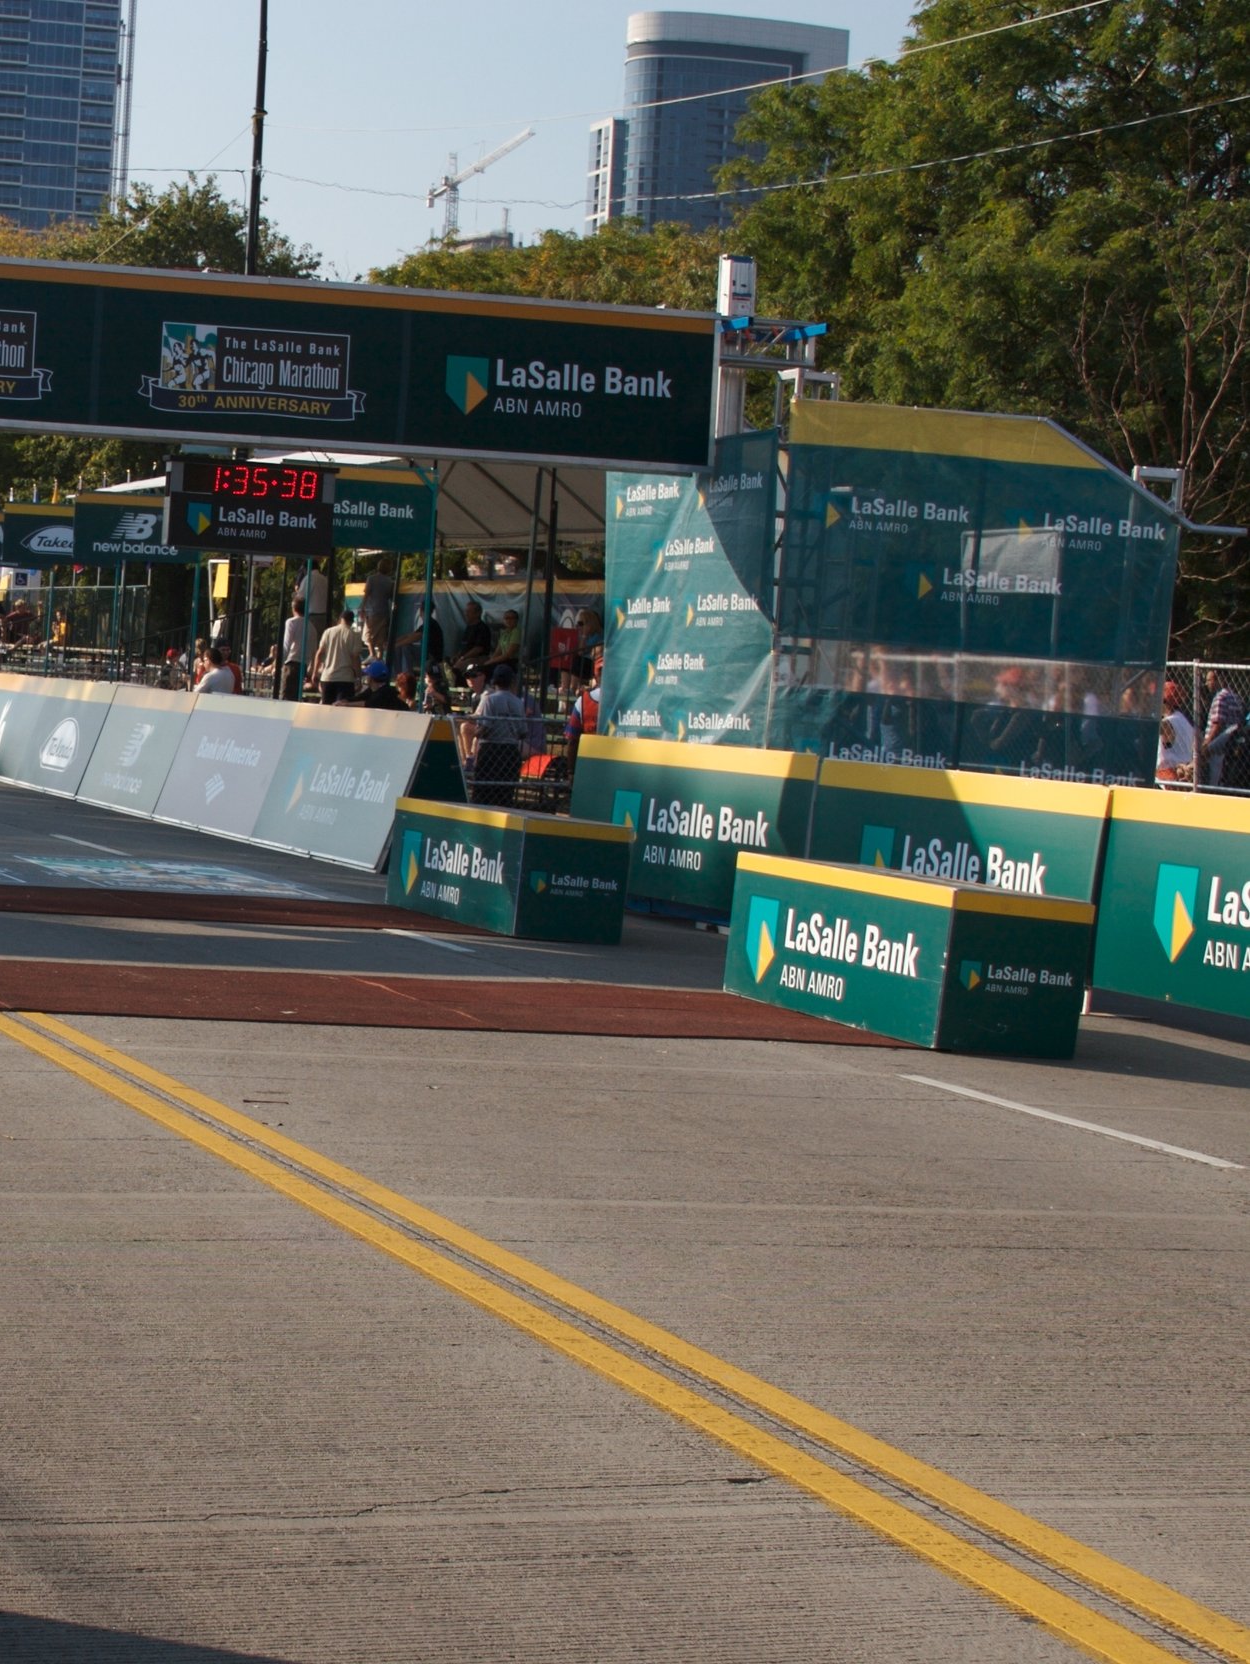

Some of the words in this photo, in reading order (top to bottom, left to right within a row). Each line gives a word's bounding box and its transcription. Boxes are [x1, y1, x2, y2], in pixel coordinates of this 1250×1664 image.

[224, 337, 247, 349] The
[254, 339, 302, 353] LaSalle
[309, 343, 340, 356] Bank
[223, 356, 274, 390] Chicago
[279, 360, 339, 390] Marathon
[496, 358, 596, 392] LaSalle
[604, 367, 672, 398] Bank
[178, 394, 207, 408] 30th
[214, 396, 331, 415] ANNIVERSARY
[493, 397, 528, 414] ABN
[533, 400, 582, 418] AMRO
[626, 486, 657, 502] LaSalle
[658, 482, 680, 500] Bank
[709, 475, 738, 493] LaSalle
[740, 472, 763, 490] Bank
[219, 507, 275, 525] LaSalle
[278, 511, 317, 530] Bank
[333, 500, 375, 517] aSalle
[379, 502, 414, 519] Bank
[851, 496, 919, 518] LaSalle
[923, 502, 970, 524] Bank
[217, 527, 237, 537] ABN
[239, 528, 267, 540] AMRO
[344, 518, 369, 528] AMRO
[849, 519, 873, 531] ABN
[876, 521, 909, 534] AMRO
[1043, 512, 1112, 536] LaSalle
[1118, 517, 1165, 541] Bank
[665, 539, 694, 556] LaSalle
[695, 537, 714, 553] Bank
[1068, 538, 1101, 551] AMRO
[943, 567, 1010, 592] LaSalle
[1014, 574, 1062, 595] Bank
[652, 597, 670, 613] Bank
[697, 595, 728, 611] LaSalle
[731, 594, 759, 611] Bank
[941, 590, 964, 603] ABN
[967, 592, 999, 605] AMRO
[657, 654, 682, 670] LaSalle
[684, 653, 704, 671] Bank
[618, 711, 641, 726] LaSalle
[642, 711, 661, 727] Bank
[688, 712, 724, 729] LaSalle
[829, 741, 895, 765] LaSalle
[900, 748, 946, 770] Bank
[310, 763, 356, 798] LaSalle
[354, 770, 391, 804] Bank
[1020, 760, 1086, 783] LaSalle
[1091, 769, 1138, 787] Bank
[647, 798, 714, 840] LaSalle
[717, 806, 769, 848] Bank
[424, 837, 468, 877] LaSalle
[471, 846, 504, 885] Bank
[643, 844, 666, 866] ABN
[668, 848, 701, 871] AMRO
[901, 834, 980, 883] LaSalle
[986, 846, 1047, 895] Bank
[420, 881, 436, 899] ABN
[438, 884, 460, 905] AMRO
[551, 874, 589, 889] LaSalle
[591, 877, 618, 891] Bank
[784, 908, 857, 964] LaSalle
[861, 924, 920, 978] Bank
[1203, 940, 1237, 970] ABN
[780, 964, 805, 988] ABN
[807, 969, 844, 1001] AMRO
[987, 964, 1036, 983] LaSalle
[1039, 969, 1073, 987] Bank
[985, 984, 1004, 993] ABN
[1005, 985, 1029, 996] AMRO
